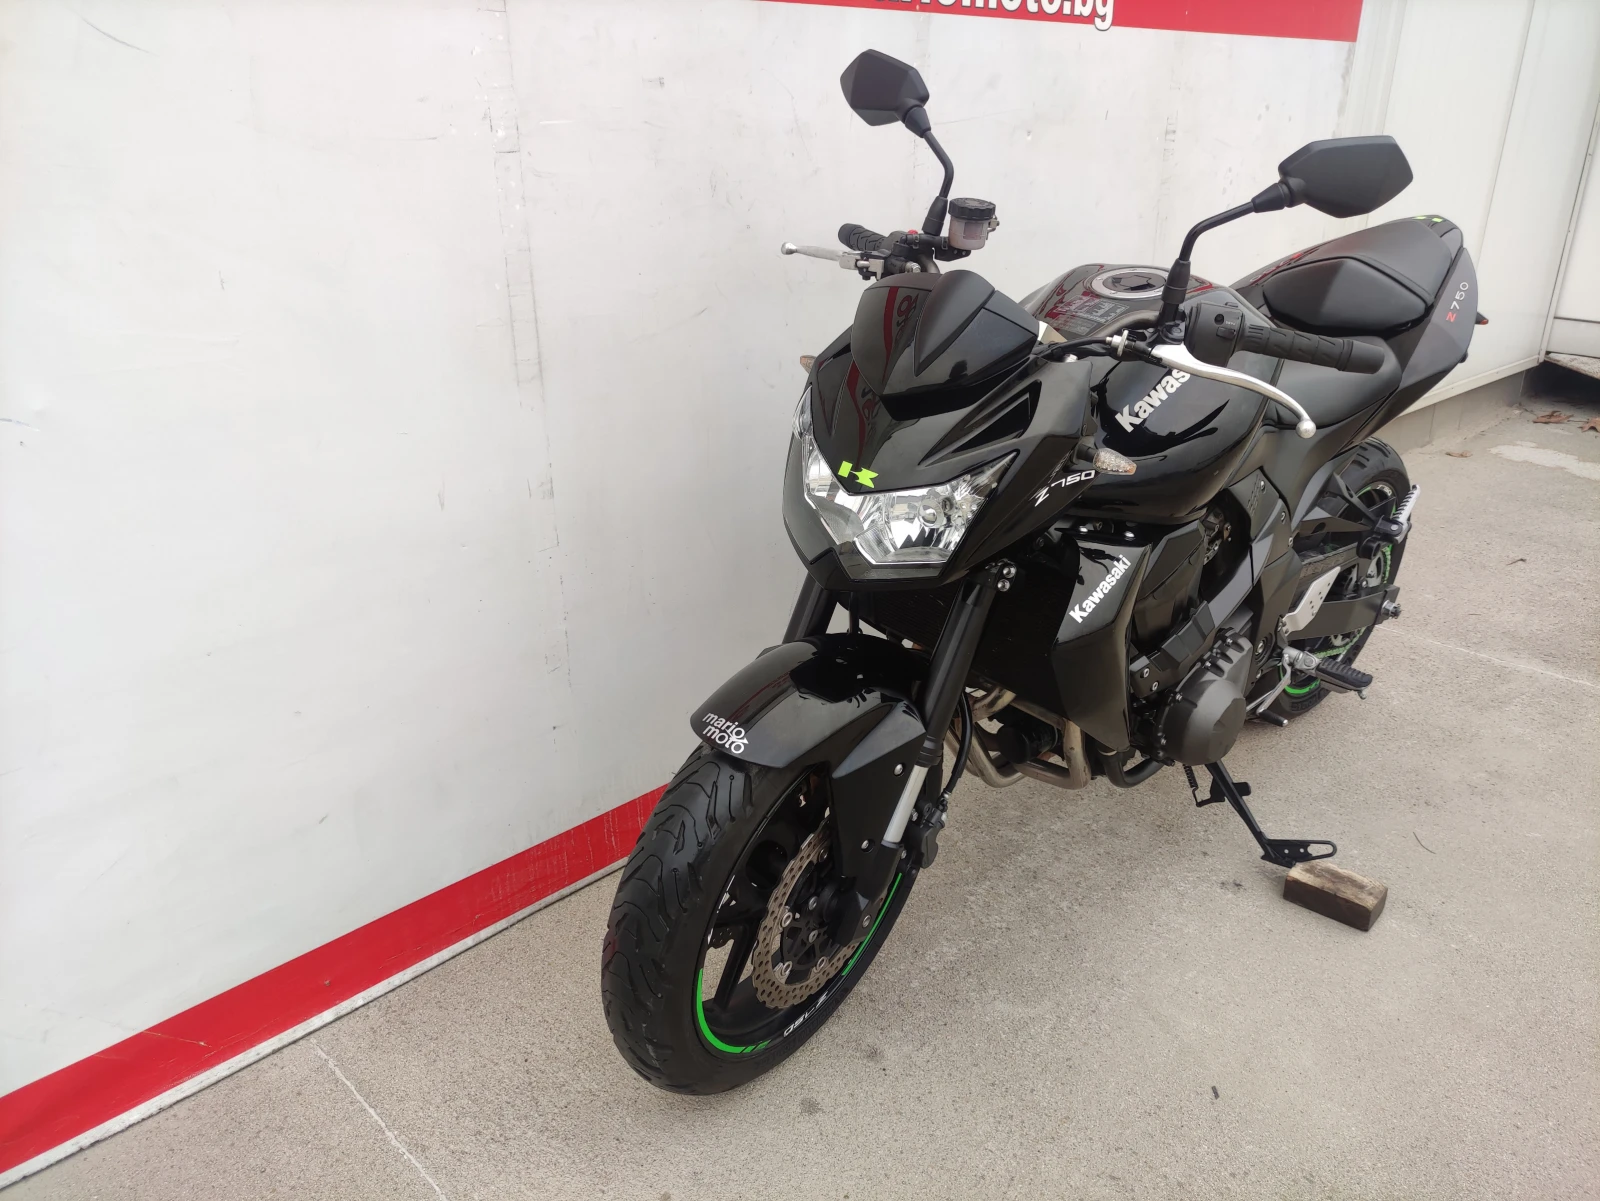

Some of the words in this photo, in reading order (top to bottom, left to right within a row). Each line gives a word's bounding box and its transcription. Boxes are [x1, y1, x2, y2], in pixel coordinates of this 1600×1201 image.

[1115, 368, 1191, 433] Kawas
[1068, 554, 1132, 624] Kawasaki
[702, 712, 745, 739] mario
[702, 725, 749, 754] moto
